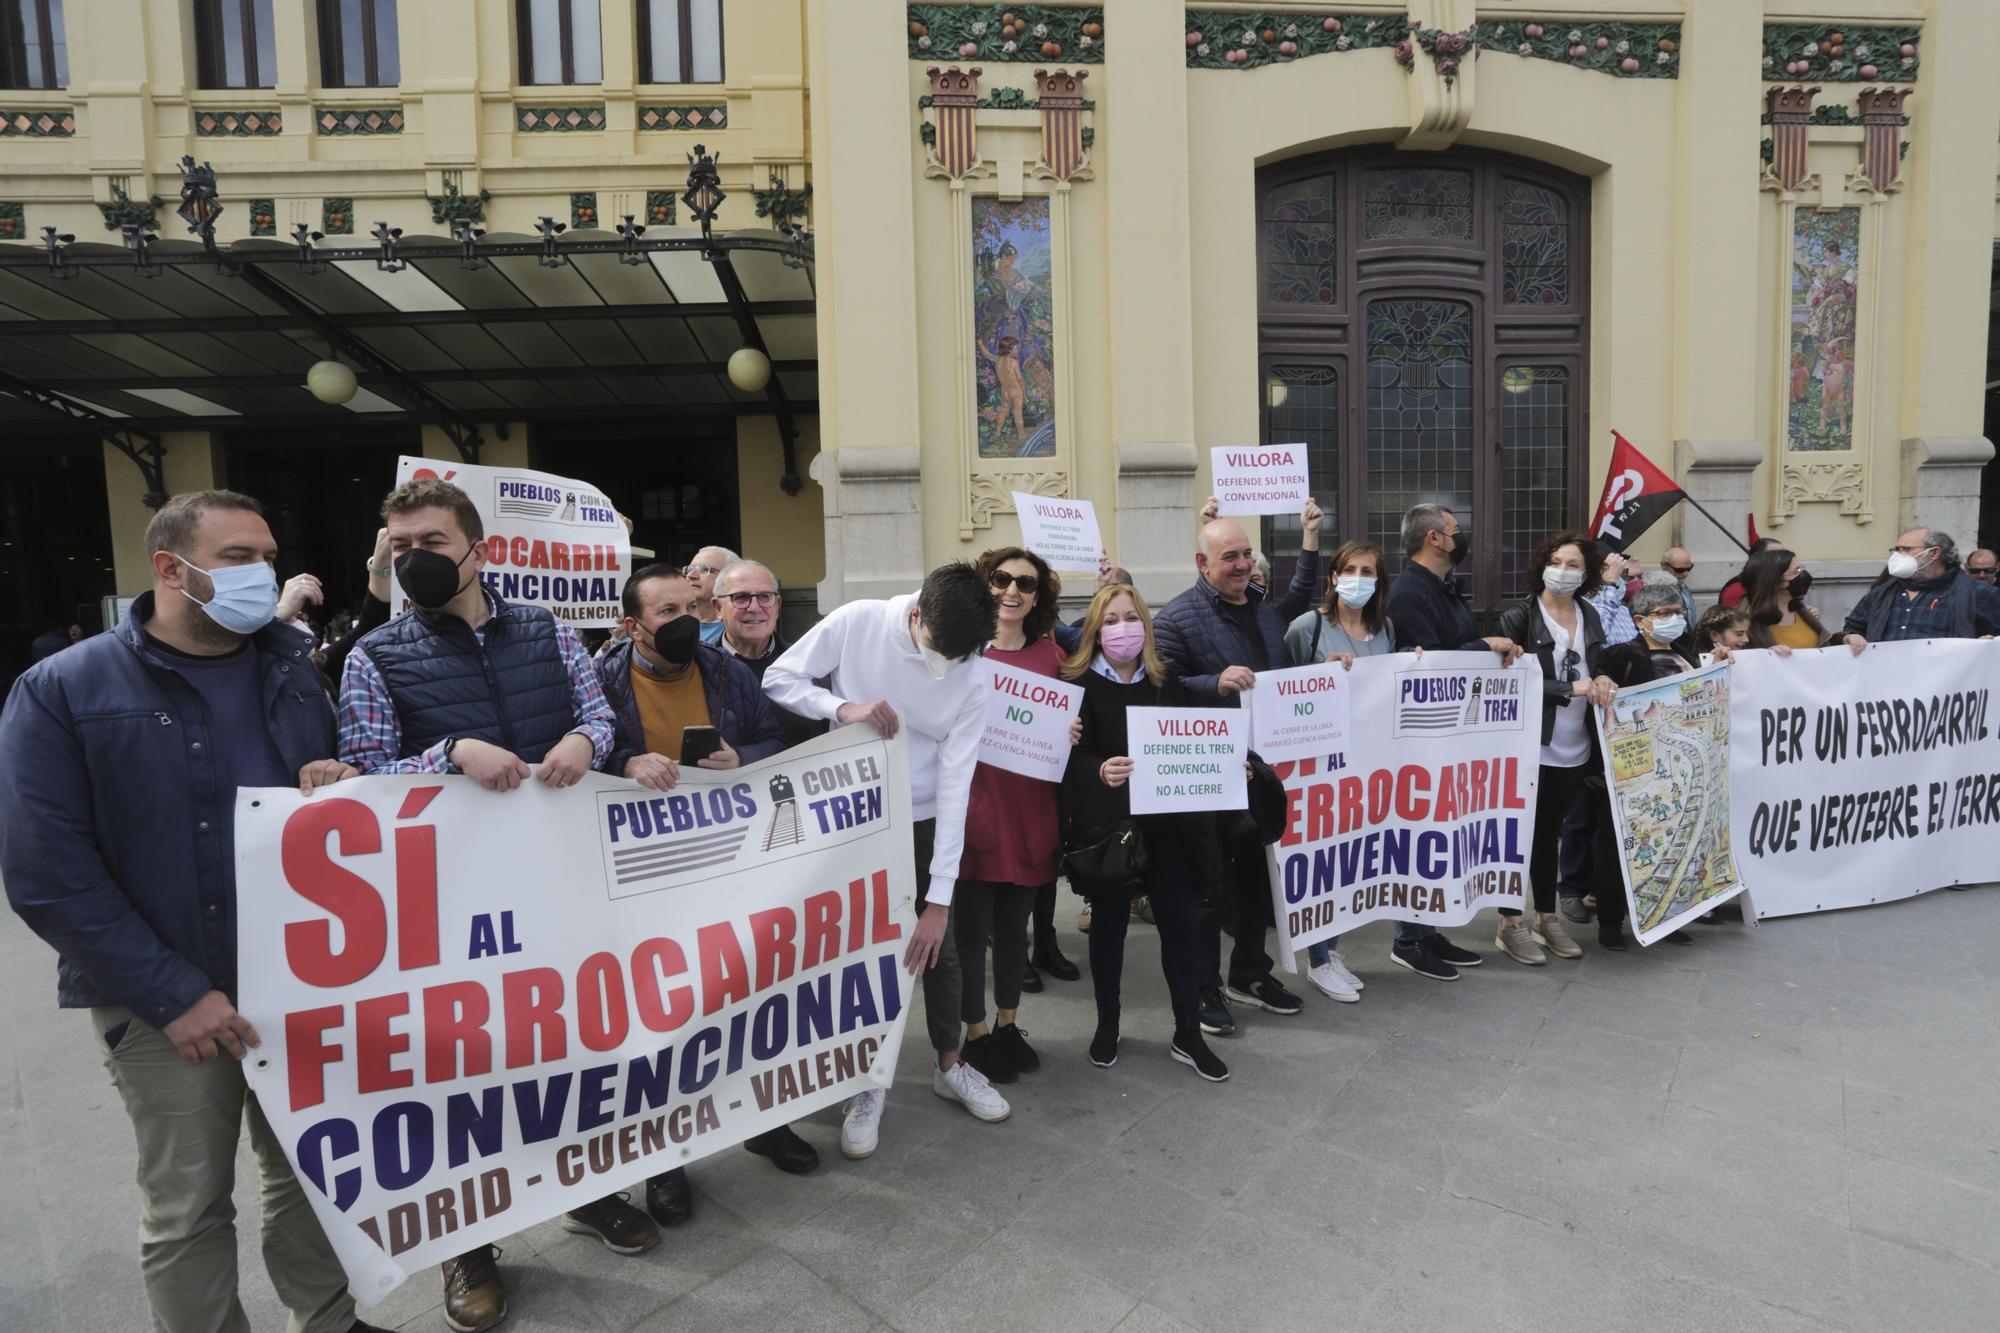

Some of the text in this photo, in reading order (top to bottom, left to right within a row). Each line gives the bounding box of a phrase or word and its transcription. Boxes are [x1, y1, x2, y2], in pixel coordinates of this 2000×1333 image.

[1226, 452, 1294, 467] VILLORA
[1217, 475, 1305, 487] DEFIENDE SU TREN
[500, 482, 561, 504] PUEBLOS
[580, 494, 600, 507] CON
[1225, 490, 1300, 502] CONVENCIONAL
[580, 507, 614, 522] TREN
[1034, 503, 1084, 520] VILLORA
[487, 535, 620, 571] OCARRIL
[553, 606, 620, 620] VALENCIA
[994, 673, 1069, 711] VILLORA
[1277, 676, 1335, 696] VILLORA
[1401, 676, 1467, 704] PUEBLOS
[1485, 678, 1519, 695] CON EL
[1006, 705, 1033, 725] NO
[1294, 701, 1314, 716] NO
[1484, 699, 1518, 722] TREN
[1158, 719, 1229, 736] VILLORA
[1761, 688, 1988, 767] PER UN FERROCARRIL
[1144, 744, 1234, 755] DEFIENDE EL TREN
[1157, 763, 1222, 775] CONVENCIAL
[1327, 752, 1346, 771] AL
[802, 756, 880, 796] CON EL
[1156, 784, 1223, 796] NO AL CIERRE
[607, 783, 757, 842] PUEBLOS
[808, 786, 882, 834] TREN
[1280, 757, 1525, 848] ERROCARRIL
[1750, 798, 1802, 859] QUE
[1810, 784, 1919, 852] VERTEBRE
[1927, 781, 1947, 835] EL
[1277, 817, 1524, 904] ONVENCIONAL
[281, 786, 444, 988] SÍ
[1289, 899, 1334, 939] DRID
[1352, 882, 1446, 913] CUENCA
[468, 910, 522, 960] AL
[285, 869, 901, 1113] FERROCARRIL
[556, 1094, 721, 1187] CUENCA
[750, 1034, 887, 1112] VALENC
